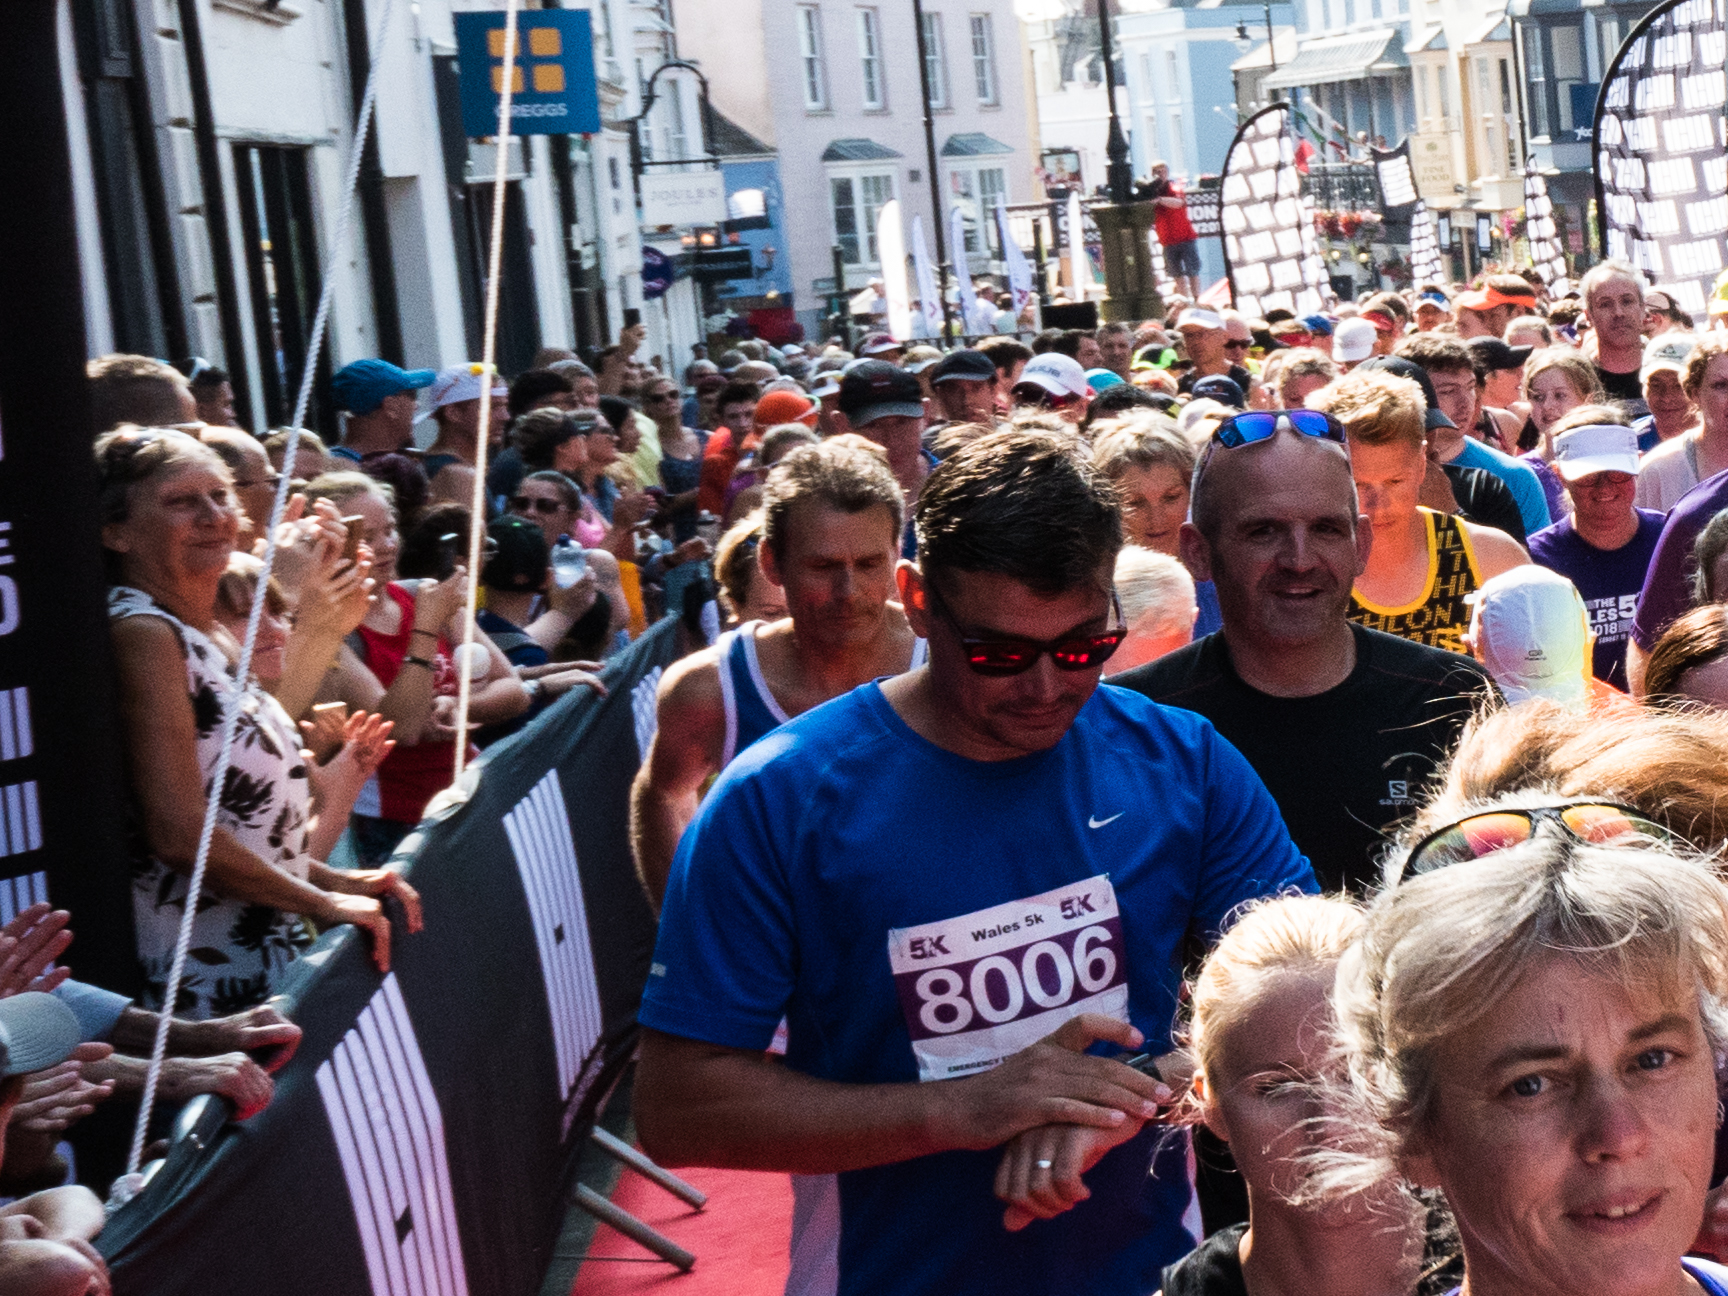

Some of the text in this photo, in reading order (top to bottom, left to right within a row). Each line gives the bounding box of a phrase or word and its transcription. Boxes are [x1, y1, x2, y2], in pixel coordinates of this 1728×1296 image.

[651, 187, 718, 201] JOULES
[1594, 596, 1616, 608] THE
[971, 922, 1020, 943] Wales
[1024, 913, 1044, 928] 5k
[915, 925, 1117, 1034] 8006
